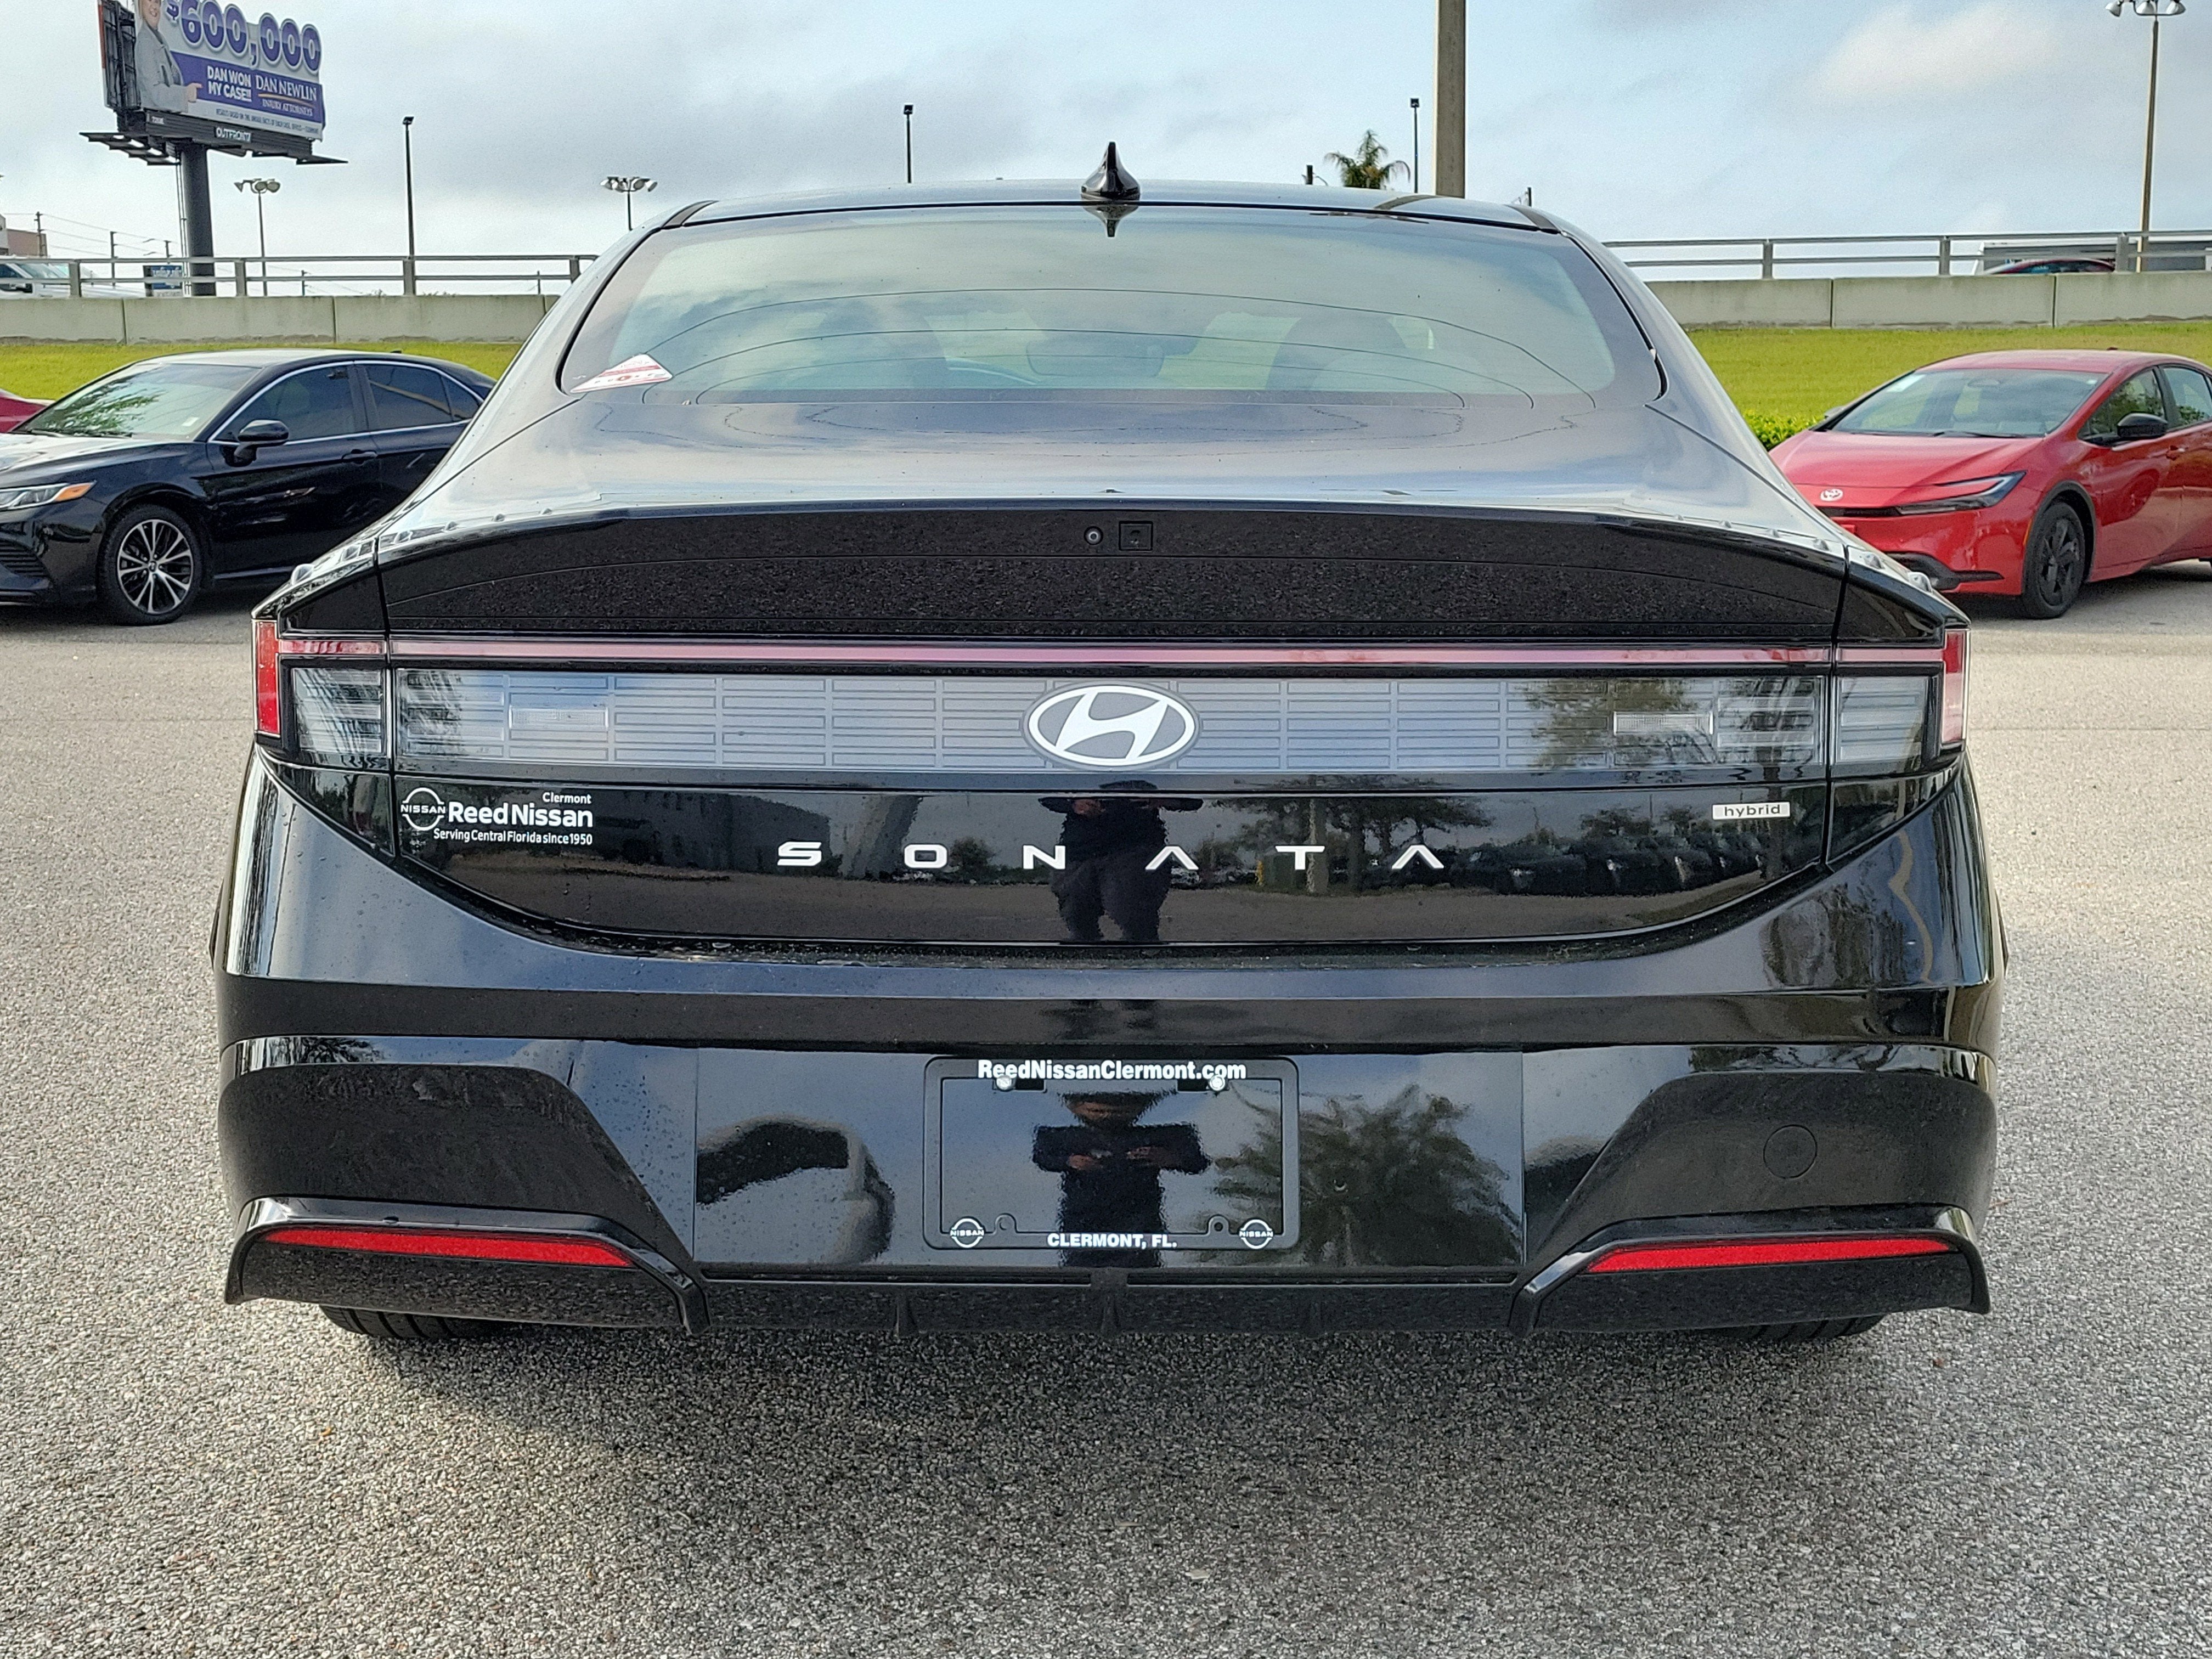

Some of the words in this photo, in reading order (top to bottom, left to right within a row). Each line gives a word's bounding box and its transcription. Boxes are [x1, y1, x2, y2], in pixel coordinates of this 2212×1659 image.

[207, 65, 228, 82] DAN
[228, 70, 251, 87] WON
[208, 81, 222, 96] MY
[255, 75, 277, 93] DAN
[278, 80, 317, 101] NEWLIN
[542, 792, 591, 804] Clermont
[400, 804, 446, 814] NISSAN
[448, 802, 509, 825] Reed
[511, 803, 593, 827] Nissan
[1724, 804, 1781, 817] hybrid
[433, 828, 470, 843] Serving
[471, 830, 506, 842] Central
[507, 831, 541, 843] Florida
[543, 832, 569, 844] since
[569, 833, 592, 845] 1950
[777, 842, 1444, 870] SONATA
[978, 1059, 1246, 1079] ReedNissanClermont.com
[1047, 1233, 1147, 1249] CLERMONT,
[1152, 1234, 1177, 1248] FL.
